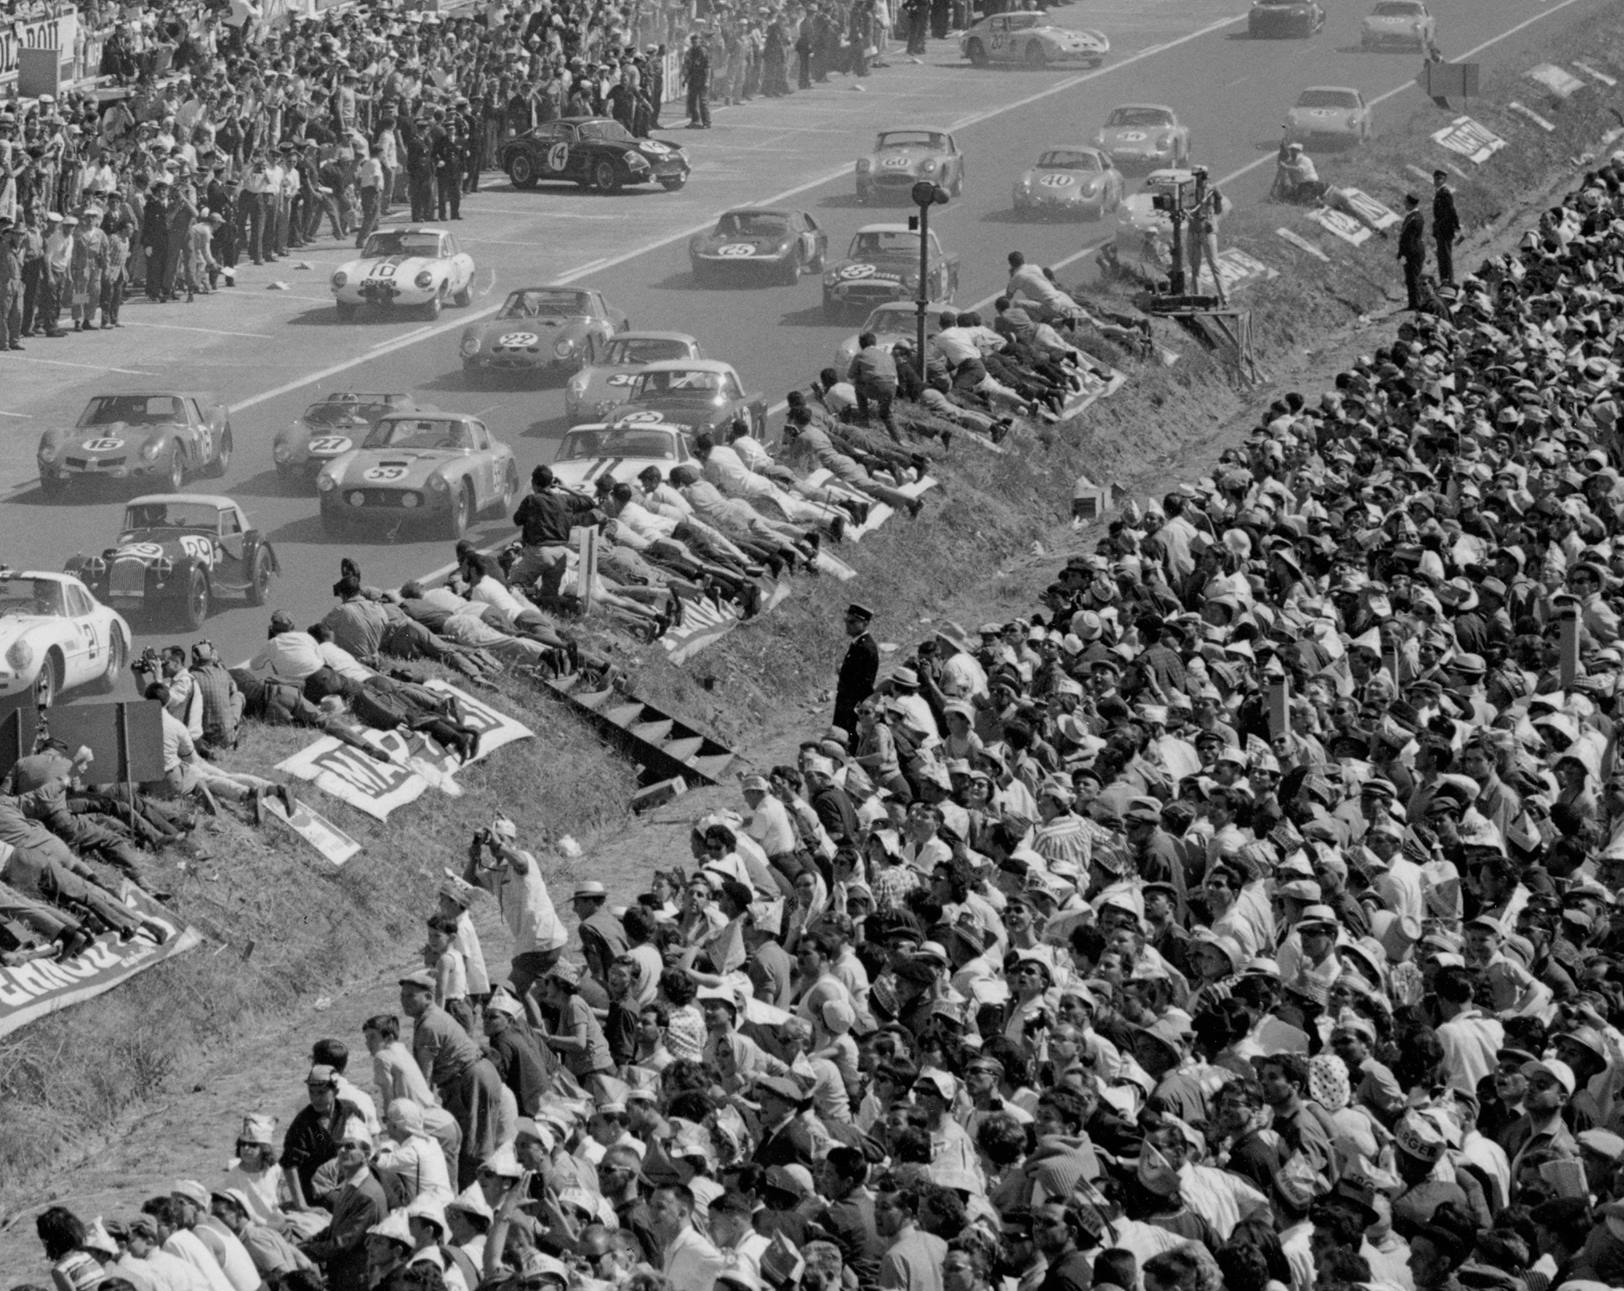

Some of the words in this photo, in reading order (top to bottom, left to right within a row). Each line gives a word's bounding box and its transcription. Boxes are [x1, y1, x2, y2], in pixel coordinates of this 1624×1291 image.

[550, 145, 565, 168] 14
[885, 157, 909, 168] 60
[1043, 174, 1071, 185] 40
[369, 264, 397, 277] 10
[503, 333, 534, 345] 22
[88, 438, 121, 451] 16
[313, 437, 345, 453] 27
